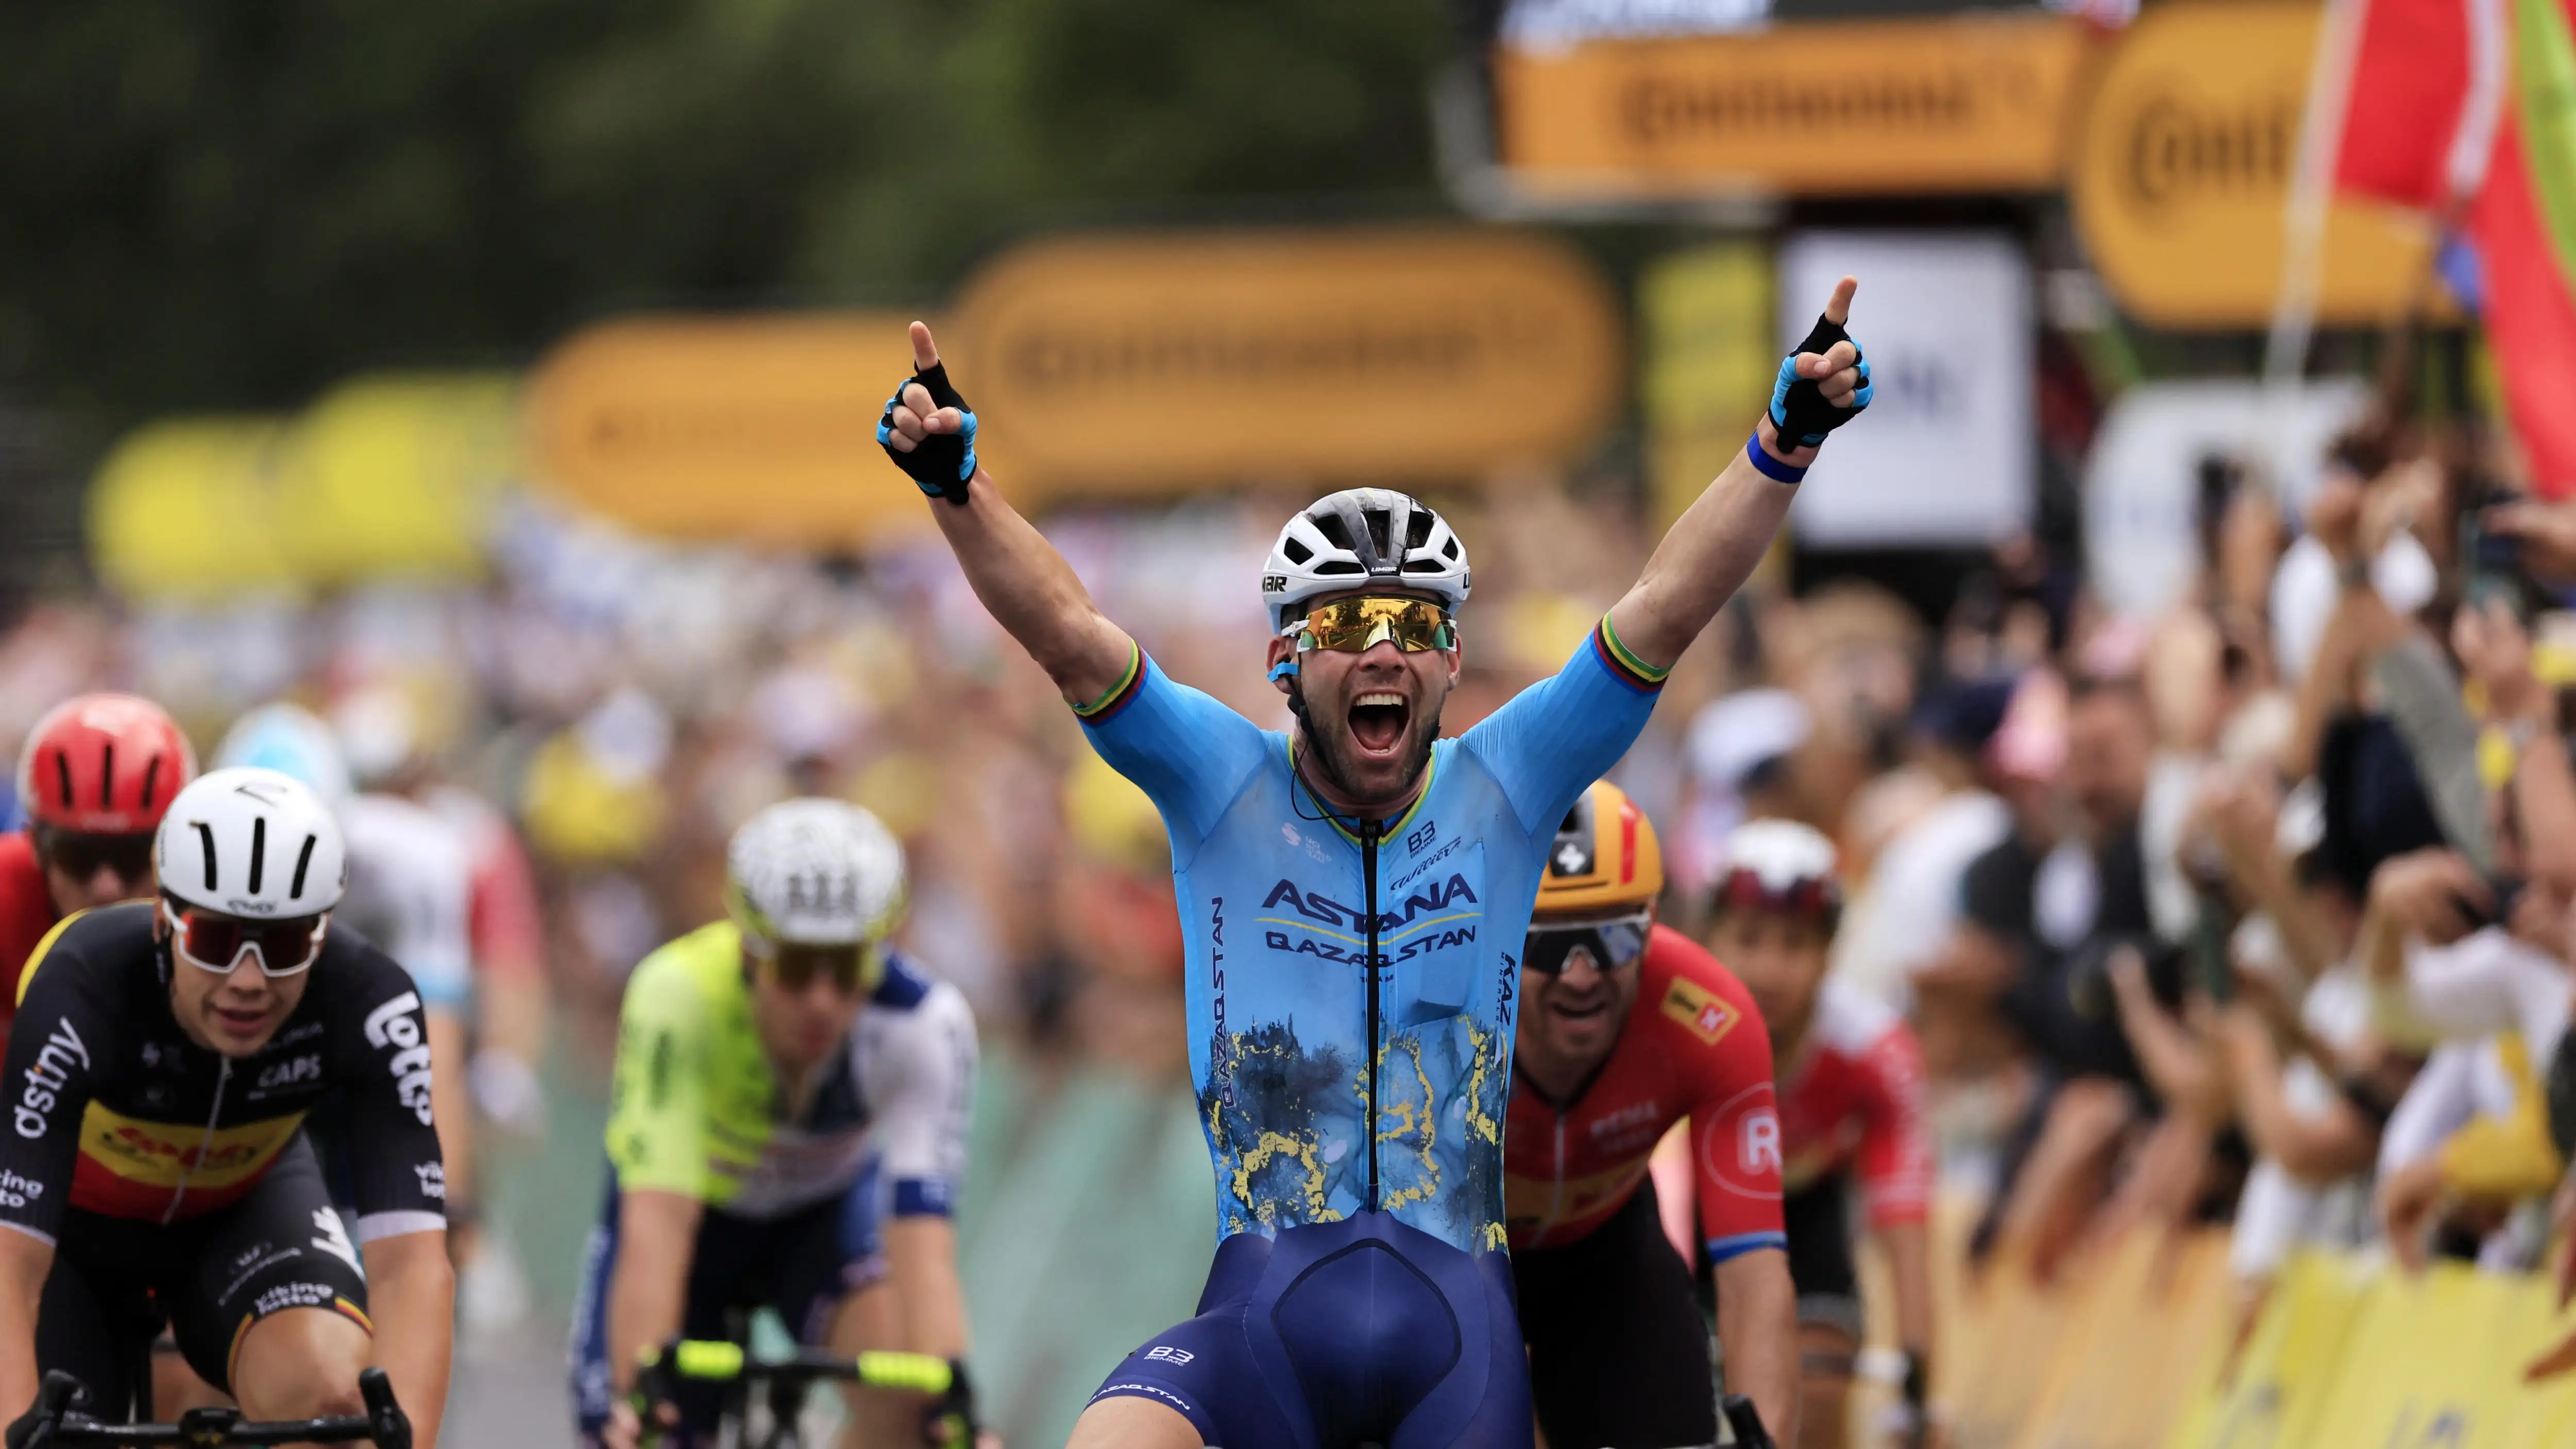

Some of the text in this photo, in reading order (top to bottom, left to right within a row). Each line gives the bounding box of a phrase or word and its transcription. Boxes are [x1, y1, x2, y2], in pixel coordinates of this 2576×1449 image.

[1408, 820, 1436, 853] B3
[1410, 834, 1437, 859] BIEMME
[1261, 873, 1478, 934] ASTANA
[1266, 925, 1476, 968] QAZAQSTAN
[1212, 896, 1235, 1109] QAZAQSTAN
[1499, 953, 1516, 1027] KAZ
[1143, 1356, 1186, 1367] BIEMME
[1147, 1346, 1195, 1363] B3
